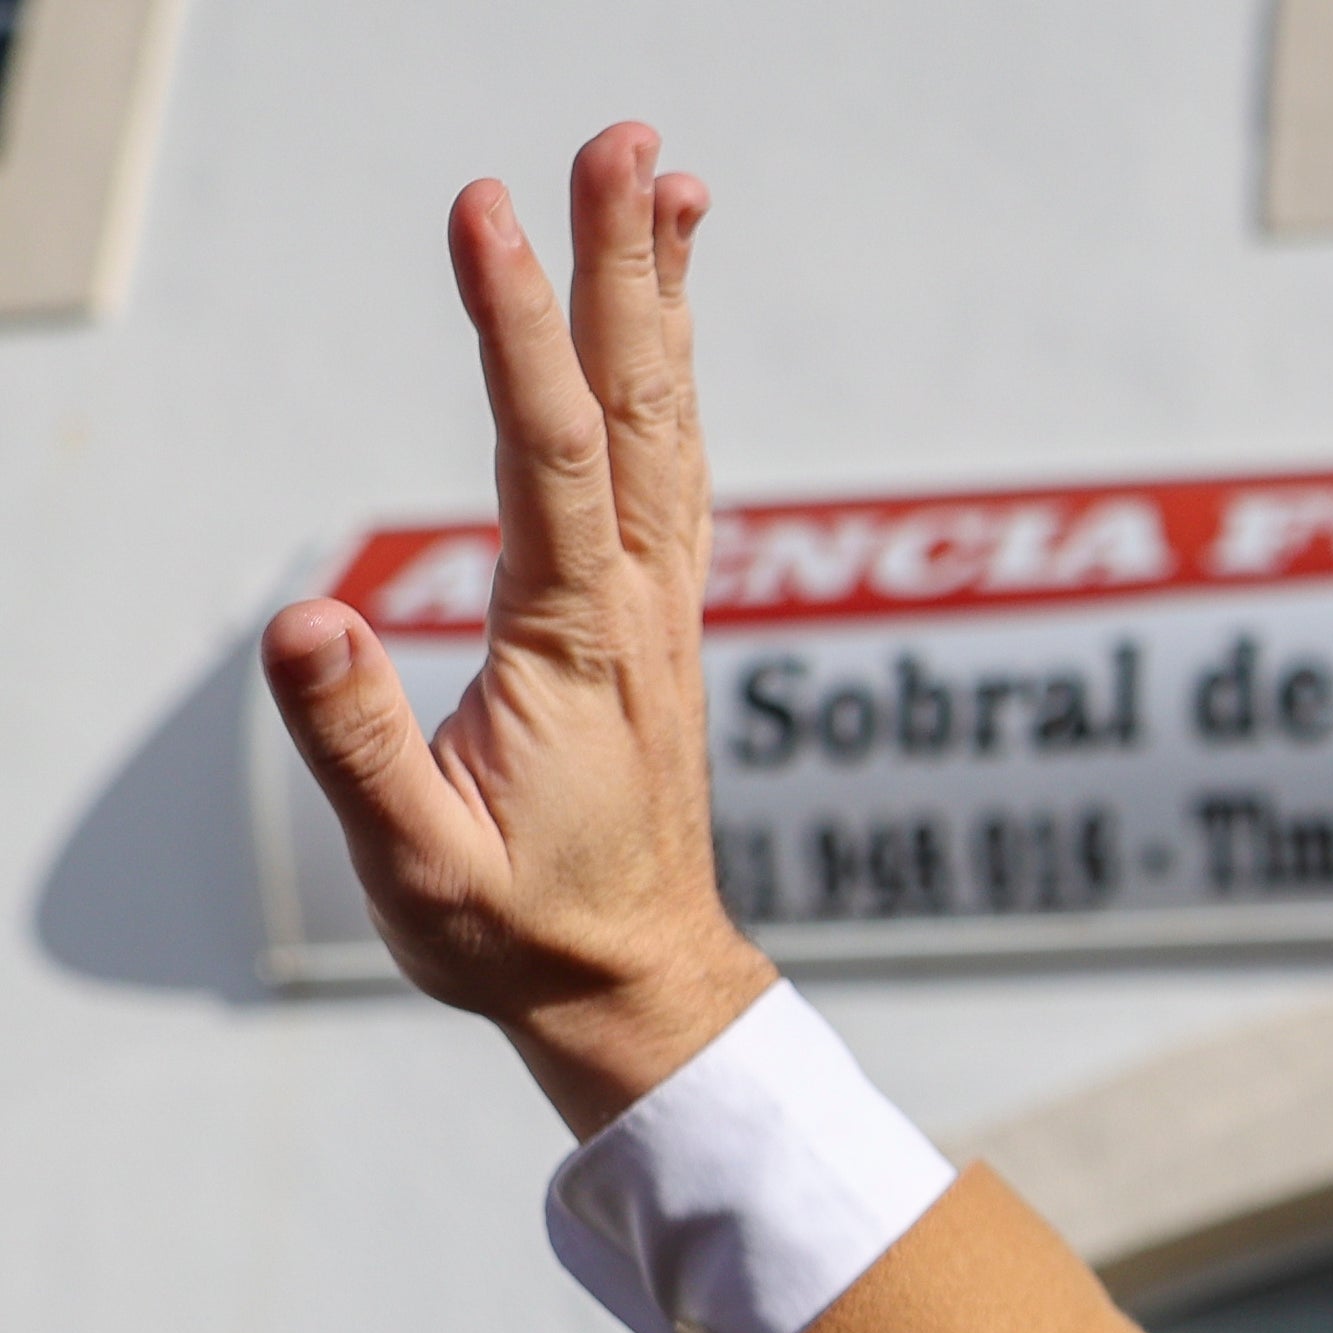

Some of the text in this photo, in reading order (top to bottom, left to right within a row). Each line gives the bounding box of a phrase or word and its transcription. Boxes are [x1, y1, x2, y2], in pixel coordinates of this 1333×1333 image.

[372, 494, 1176, 626] ANCIA
[736, 640, 1146, 764] Sobral
[1197, 632, 1333, 742] de
